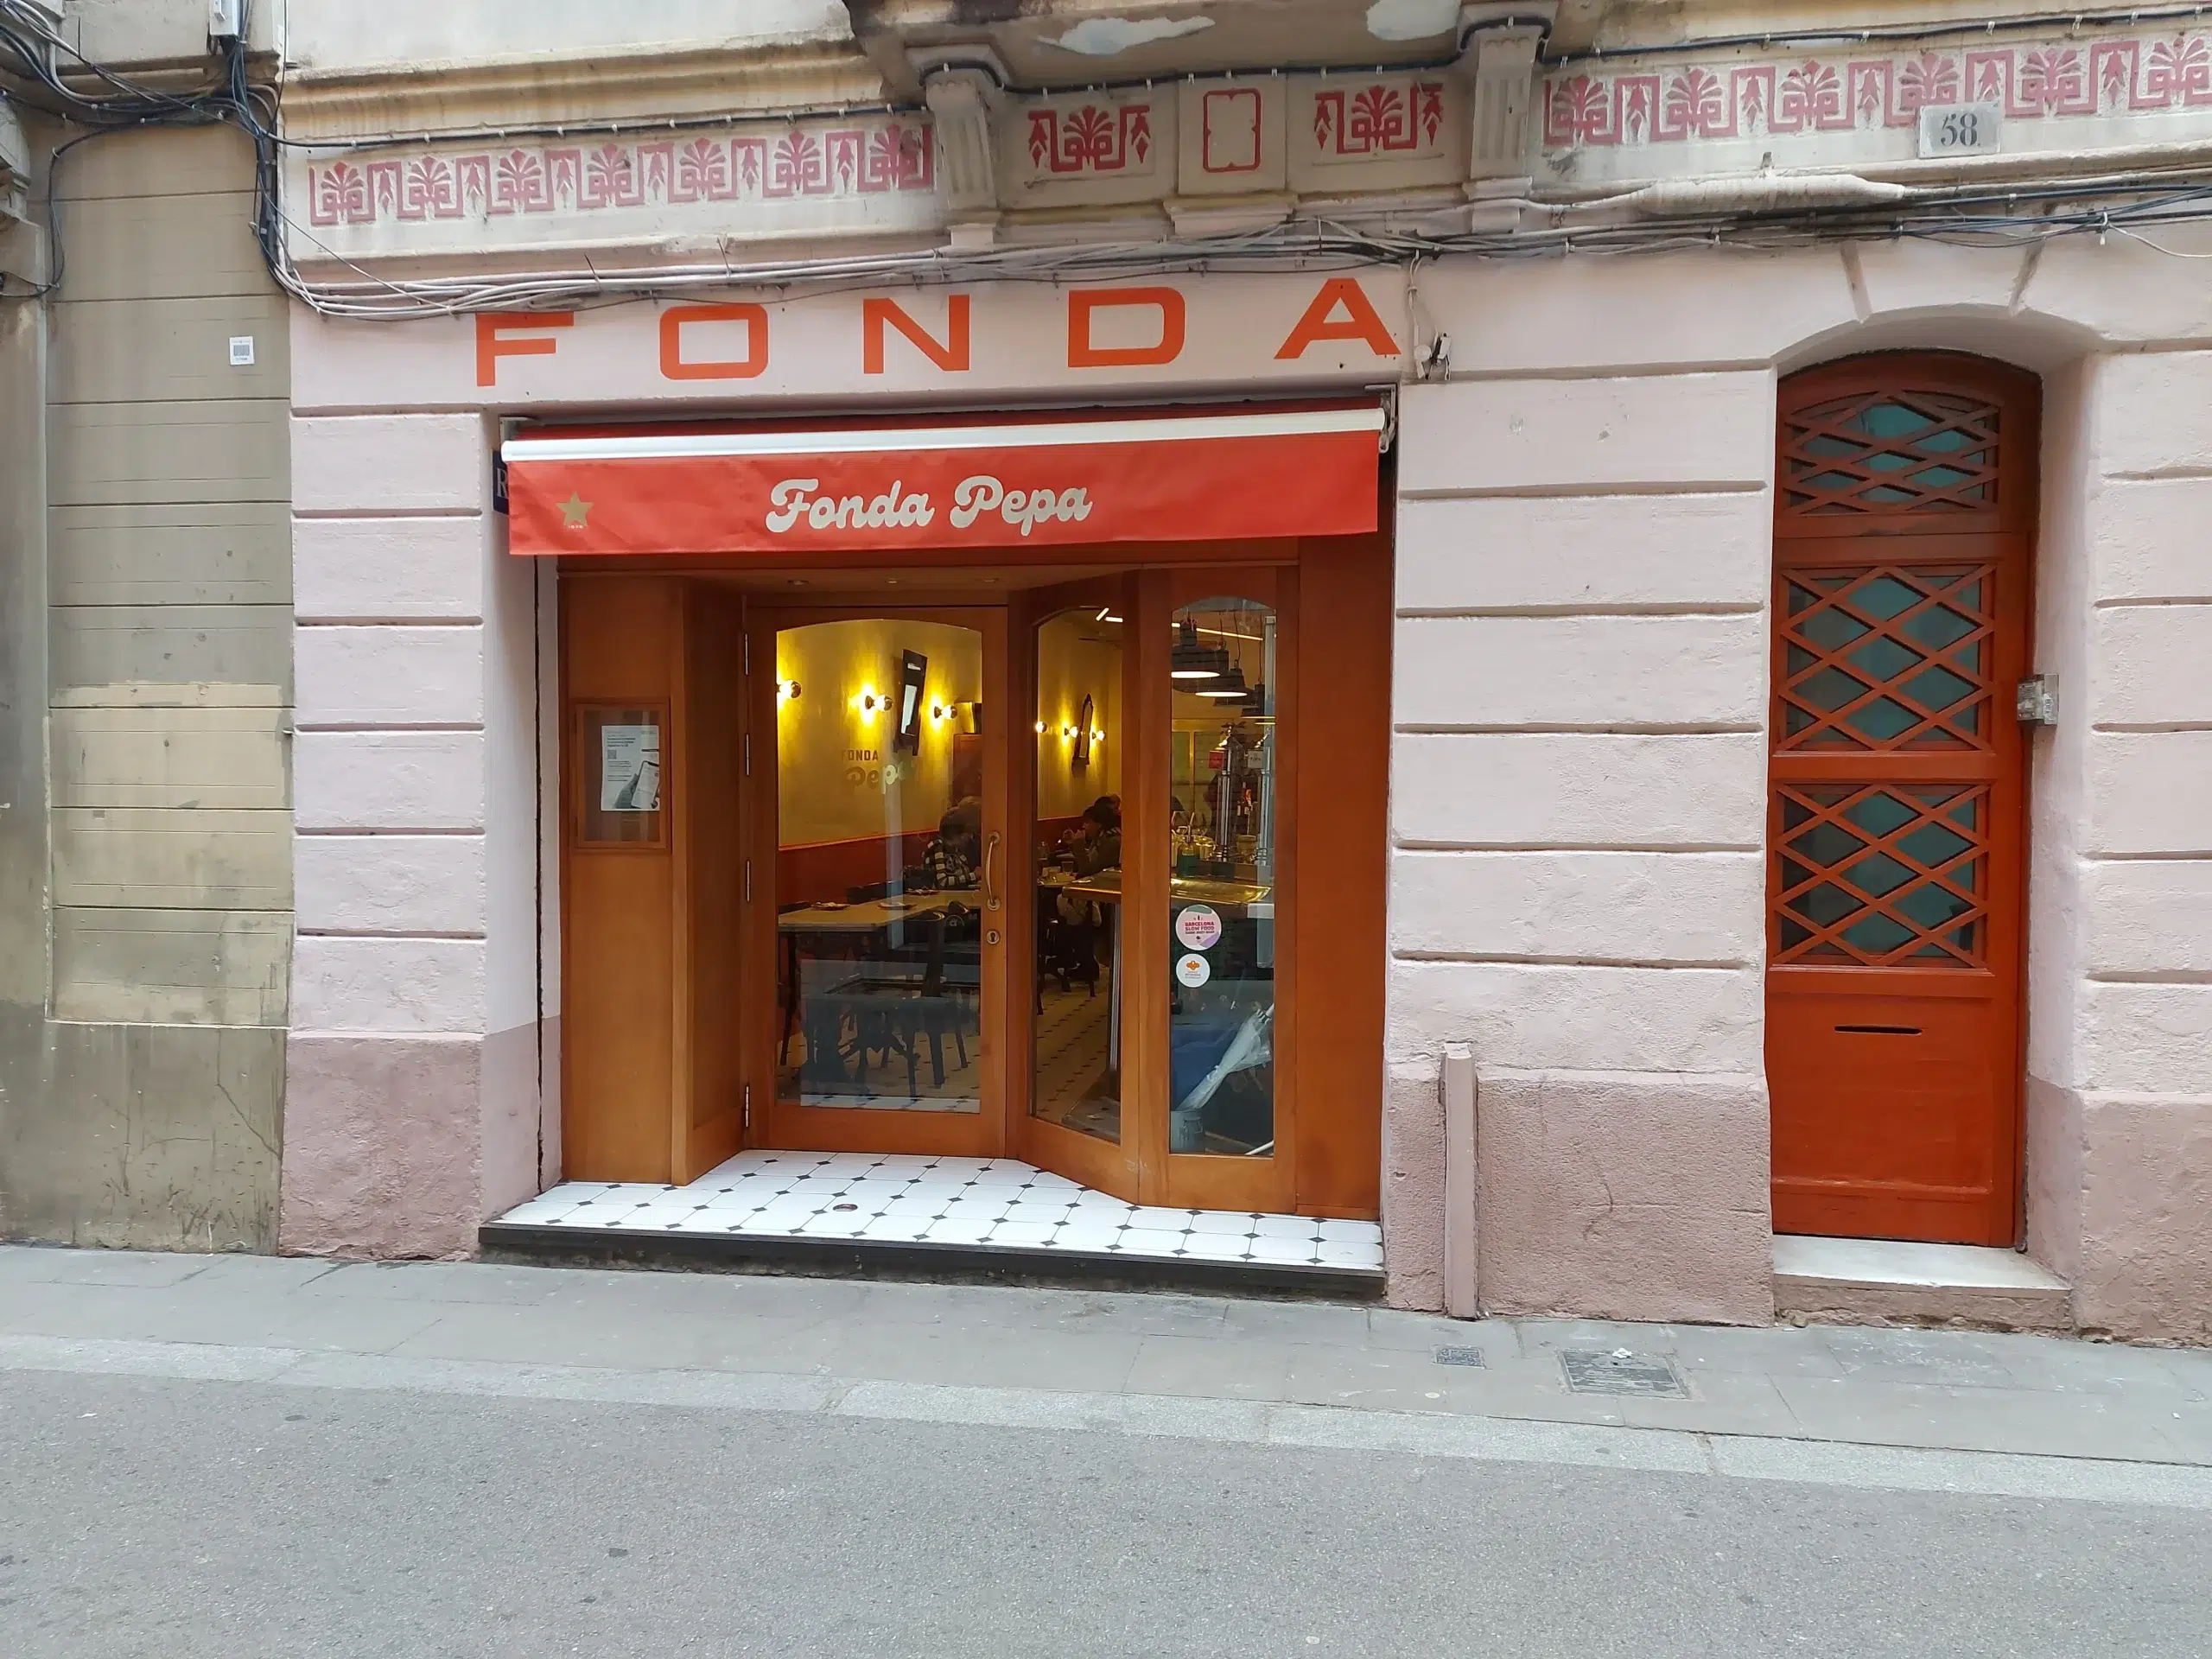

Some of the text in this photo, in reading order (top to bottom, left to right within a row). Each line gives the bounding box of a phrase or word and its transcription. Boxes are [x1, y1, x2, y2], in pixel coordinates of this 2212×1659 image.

[476, 276, 1402, 387] FONDA
[766, 475, 1093, 537] Fonda Pepa
[842, 749, 879, 761] FONDA
[845, 764, 907, 795] Pep
